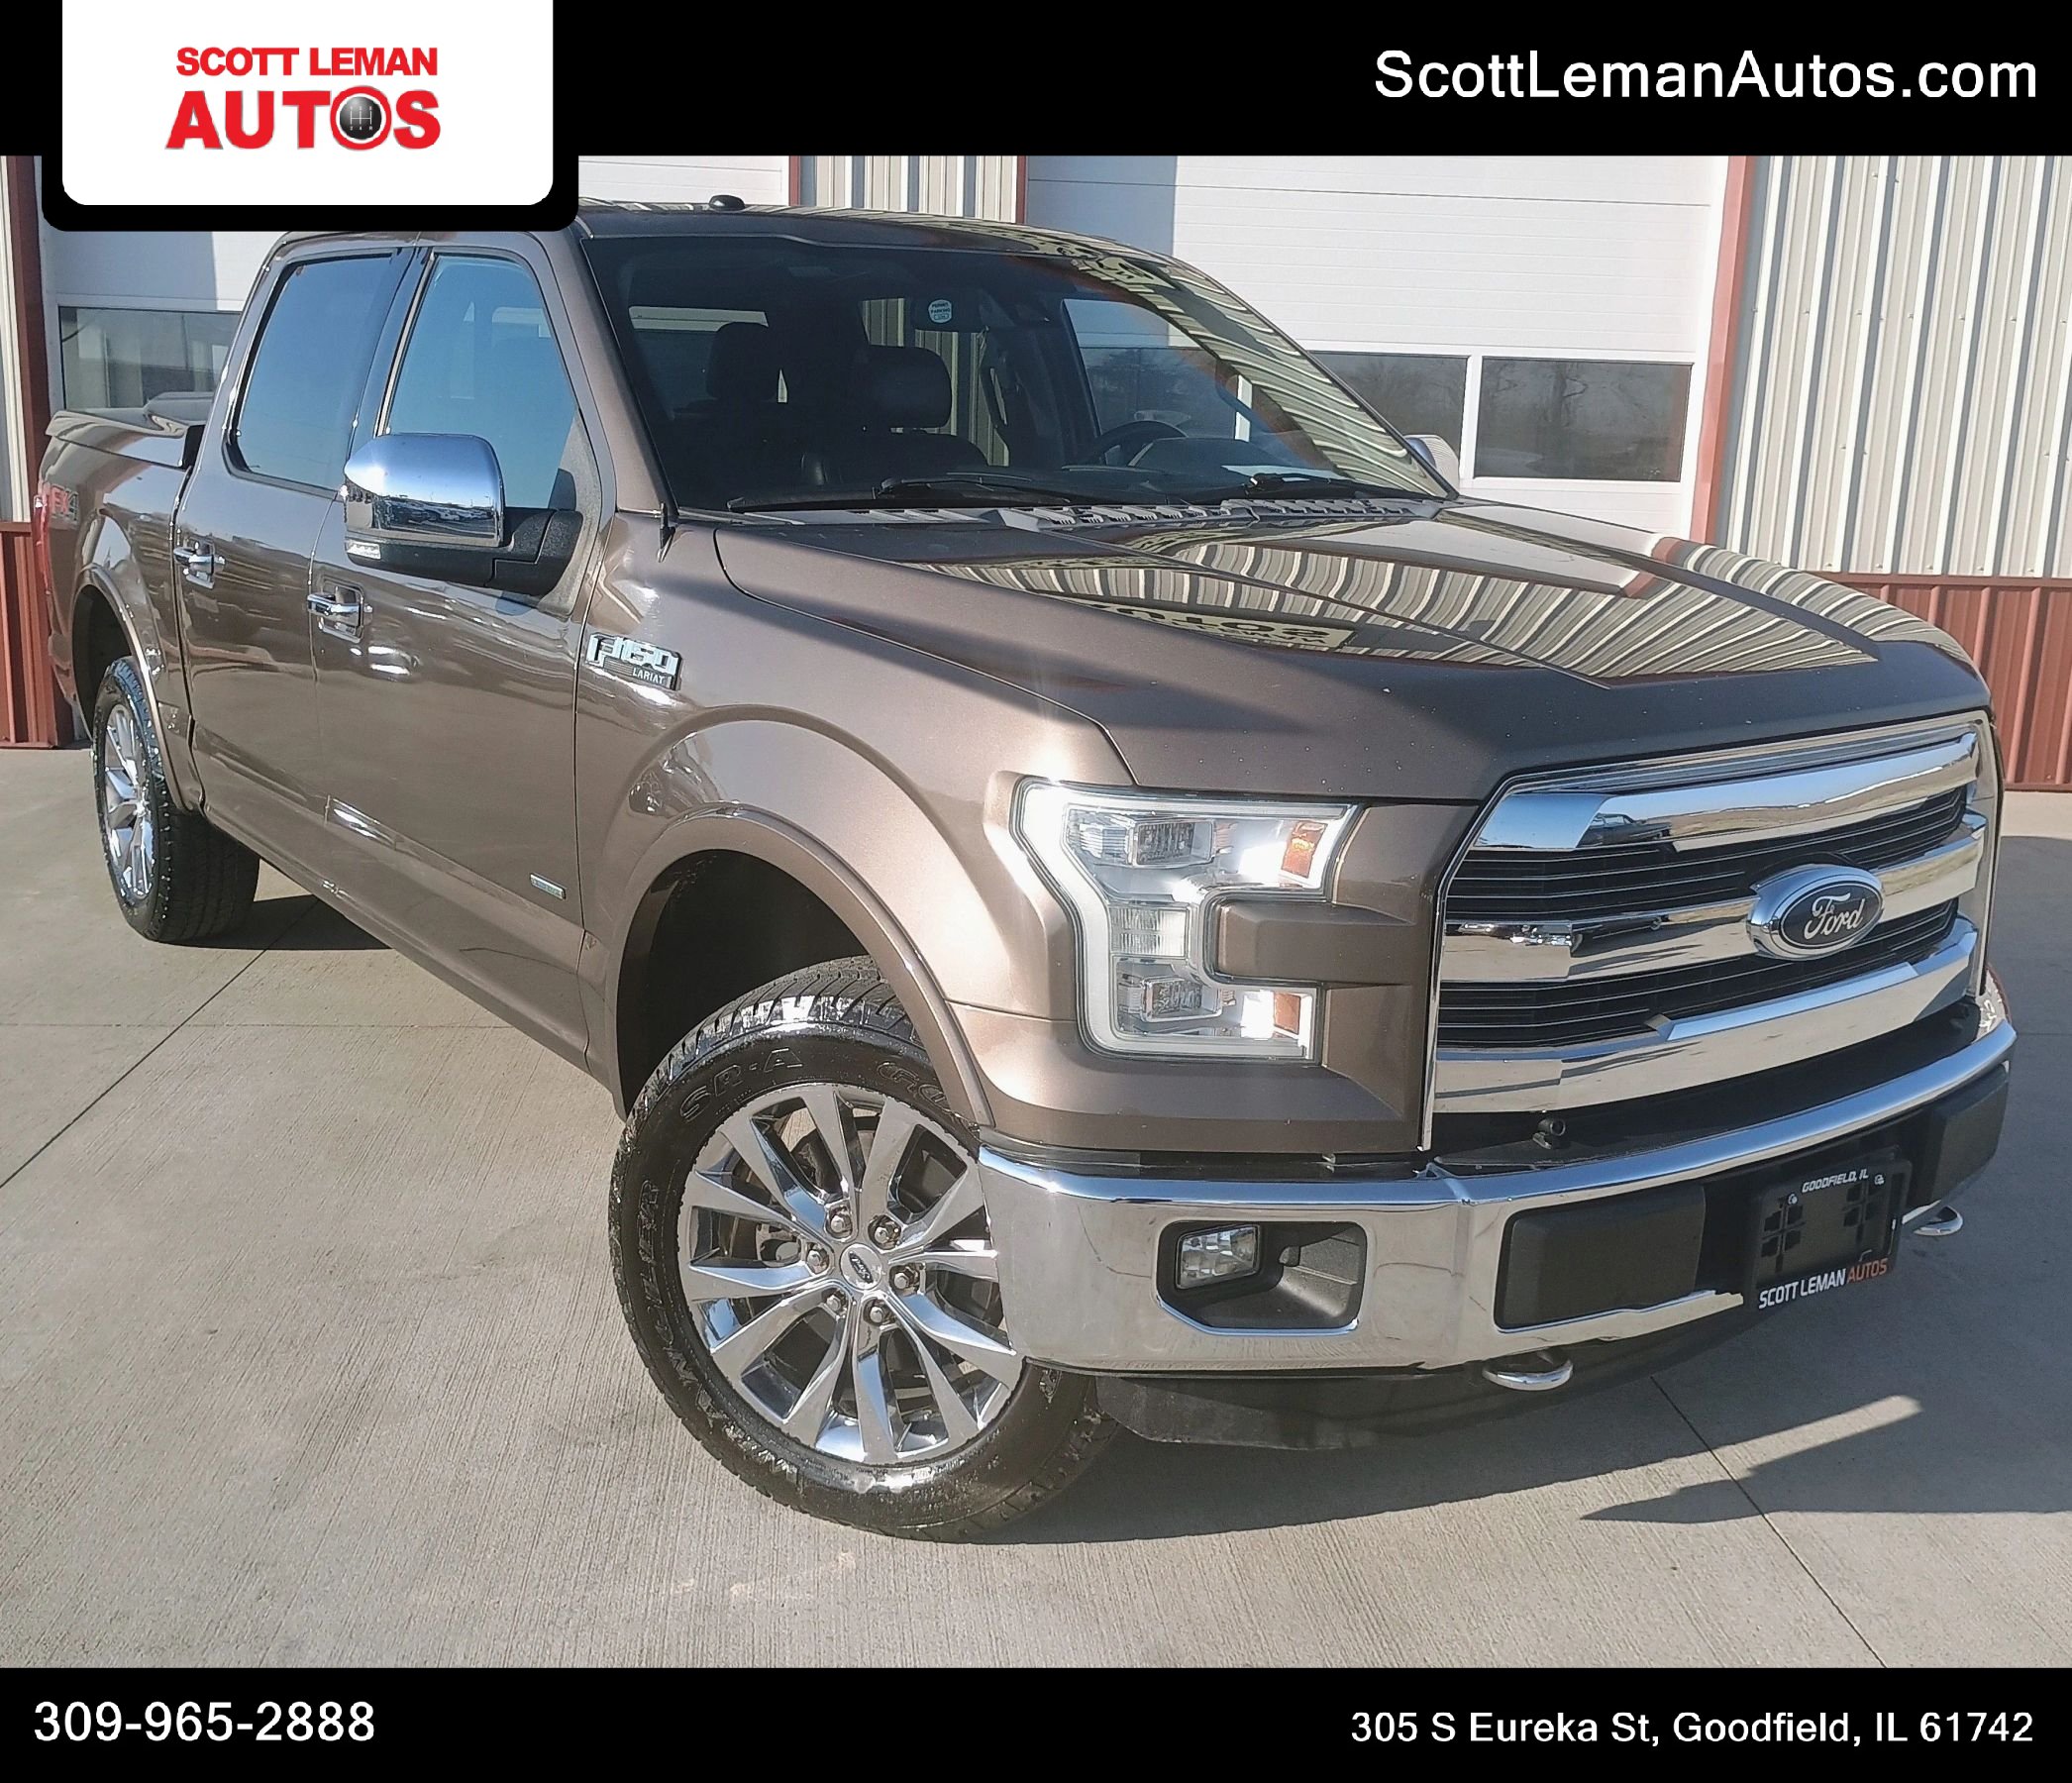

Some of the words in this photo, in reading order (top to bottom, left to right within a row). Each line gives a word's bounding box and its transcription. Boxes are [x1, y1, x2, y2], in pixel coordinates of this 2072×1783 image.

[632, 668, 666, 684] LARIAT
[1804, 892, 1865, 940] Ford
[1802, 1171, 1857, 1194] GOODFIELD,
[1859, 1169, 1869, 1179] IL
[1758, 1281, 1799, 1310] SCOTT
[1800, 1268, 1847, 1297] LEMAN
[1847, 1258, 1889, 1283] AUTOS
